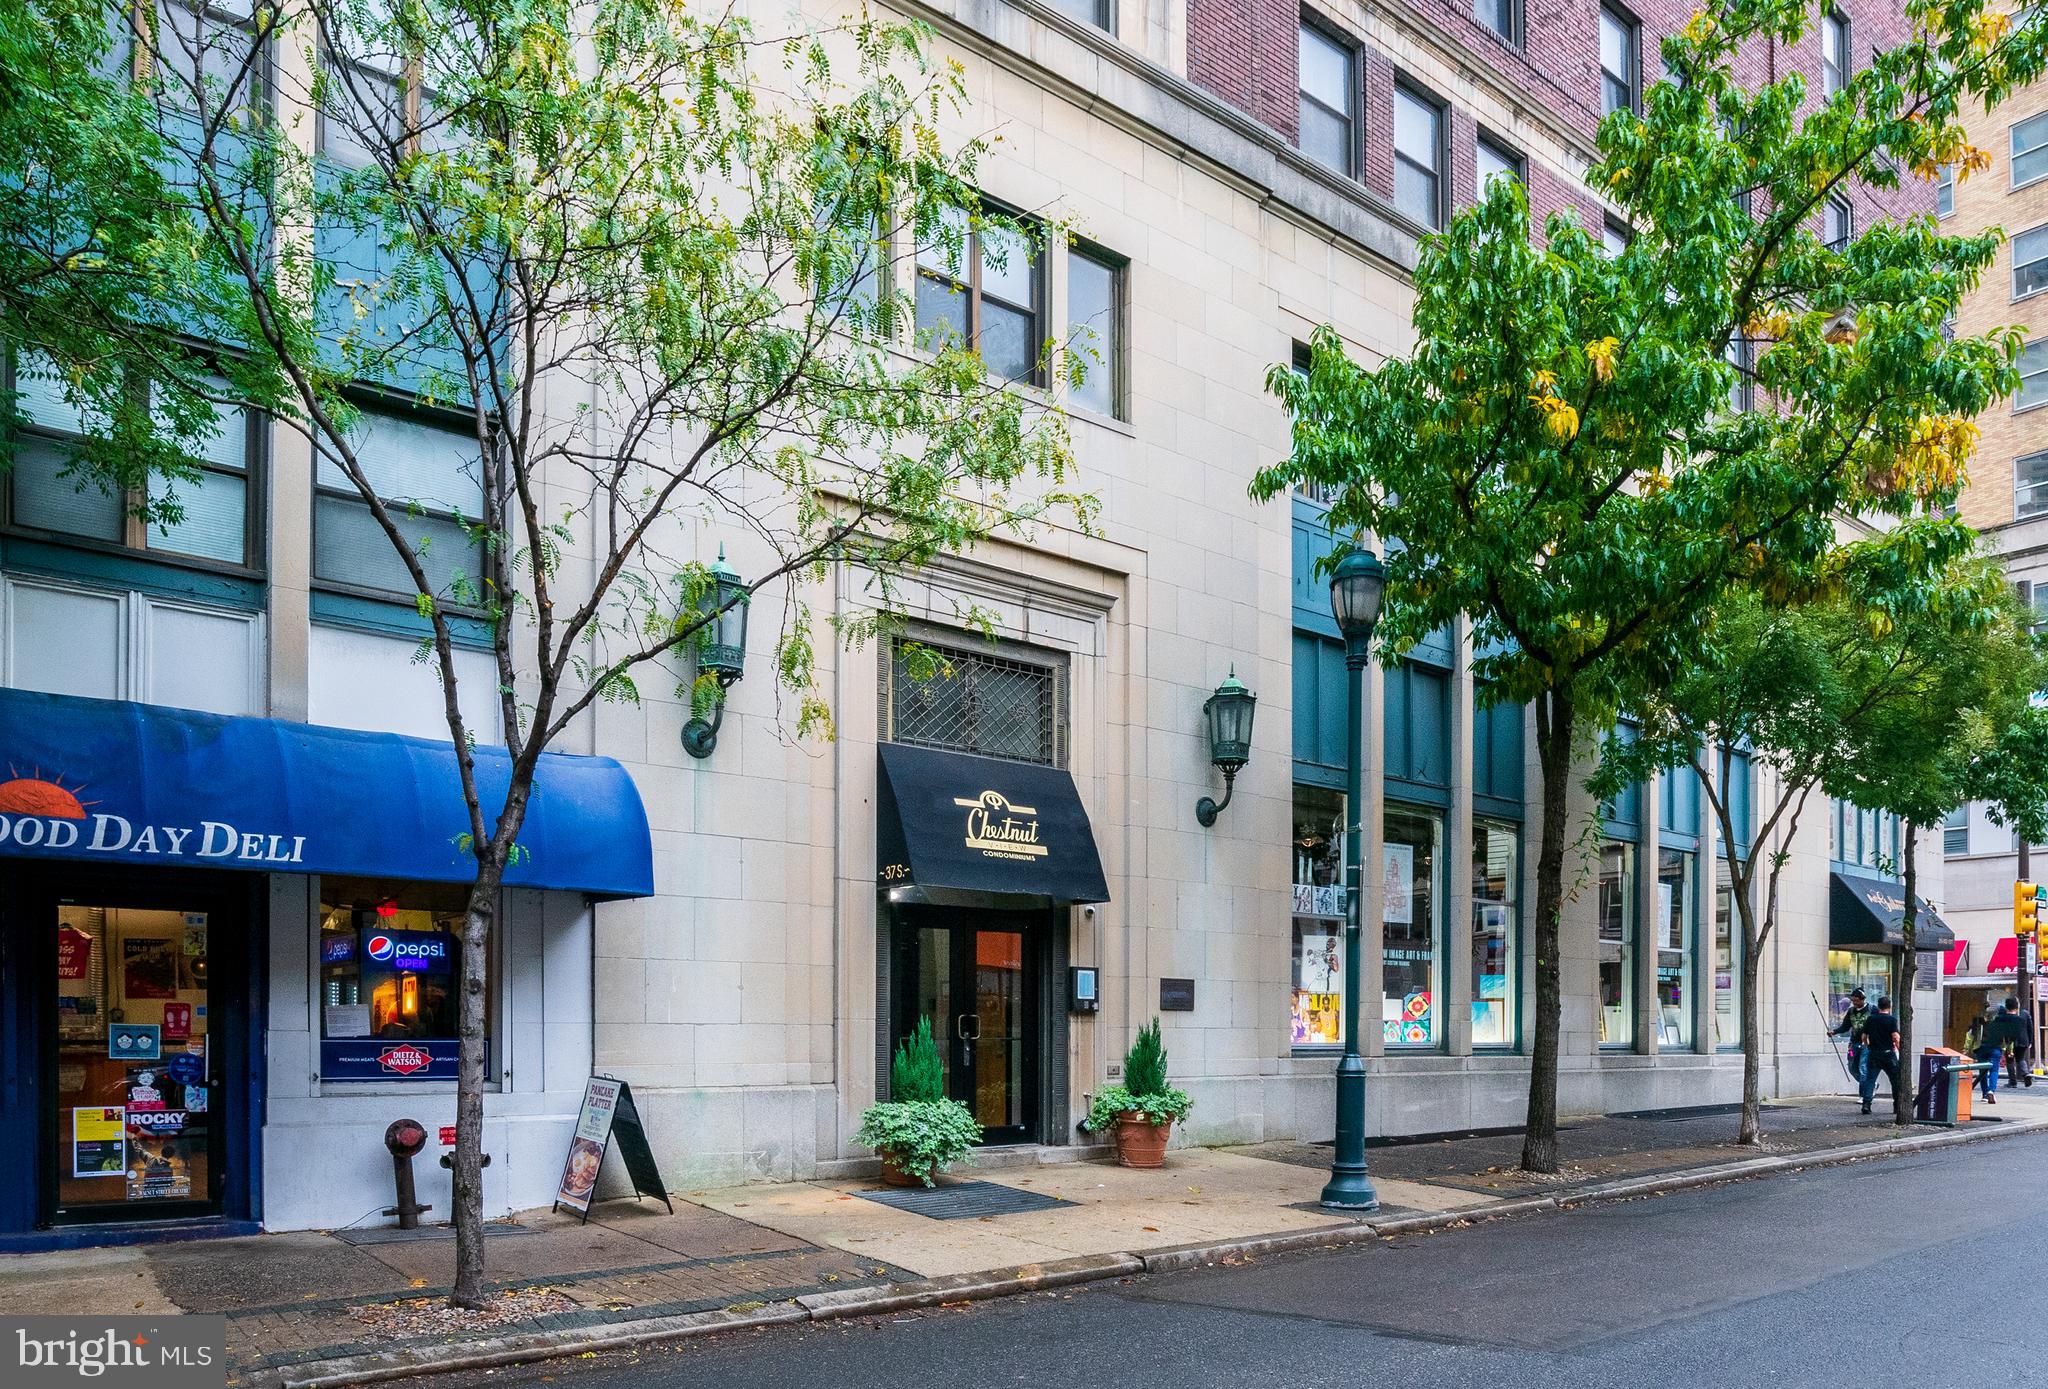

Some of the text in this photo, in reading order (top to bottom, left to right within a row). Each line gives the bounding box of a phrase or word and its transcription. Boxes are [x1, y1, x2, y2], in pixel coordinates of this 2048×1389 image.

[967, 807, 1039, 842] Chestnut
[86, 813, 193, 855] DAY
[196, 821, 306, 862] DELI
[983, 850, 1036, 861] CONDOMINIUMS
[396, 943, 443, 959] pepsi
[395, 958, 428, 968] OPEN
[403, 980, 416, 992] ATM
[392, 1051, 422, 1059] DIETZ &
[387, 1058, 422, 1066] WATSON
[587, 1096, 612, 1111] PLATTER
[130, 1112, 186, 1125] ROCKY
